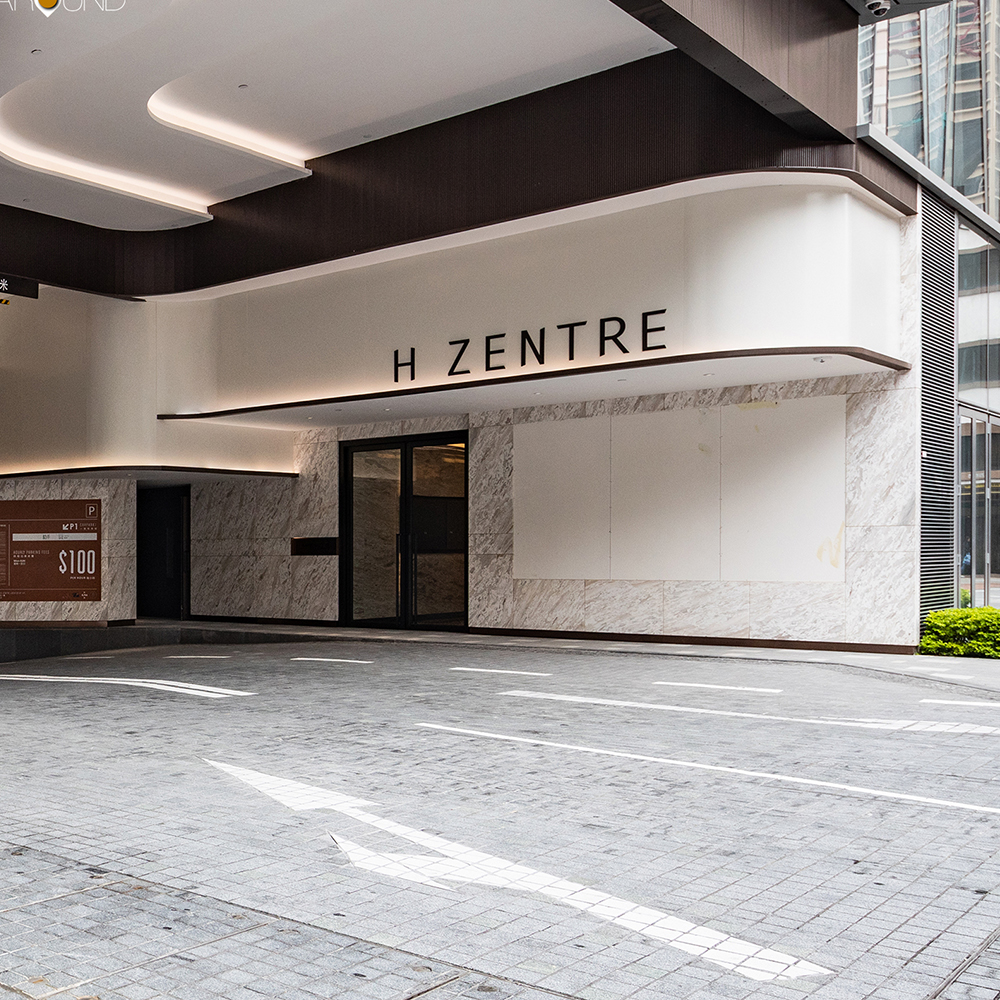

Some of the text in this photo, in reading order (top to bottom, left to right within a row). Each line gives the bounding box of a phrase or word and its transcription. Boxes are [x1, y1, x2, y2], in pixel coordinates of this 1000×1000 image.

[393, 308, 668, 383] H ZENTRE
[88, 505, 96, 516] P
[69, 522, 78, 531] P1
[58, 549, 96, 574] $100
